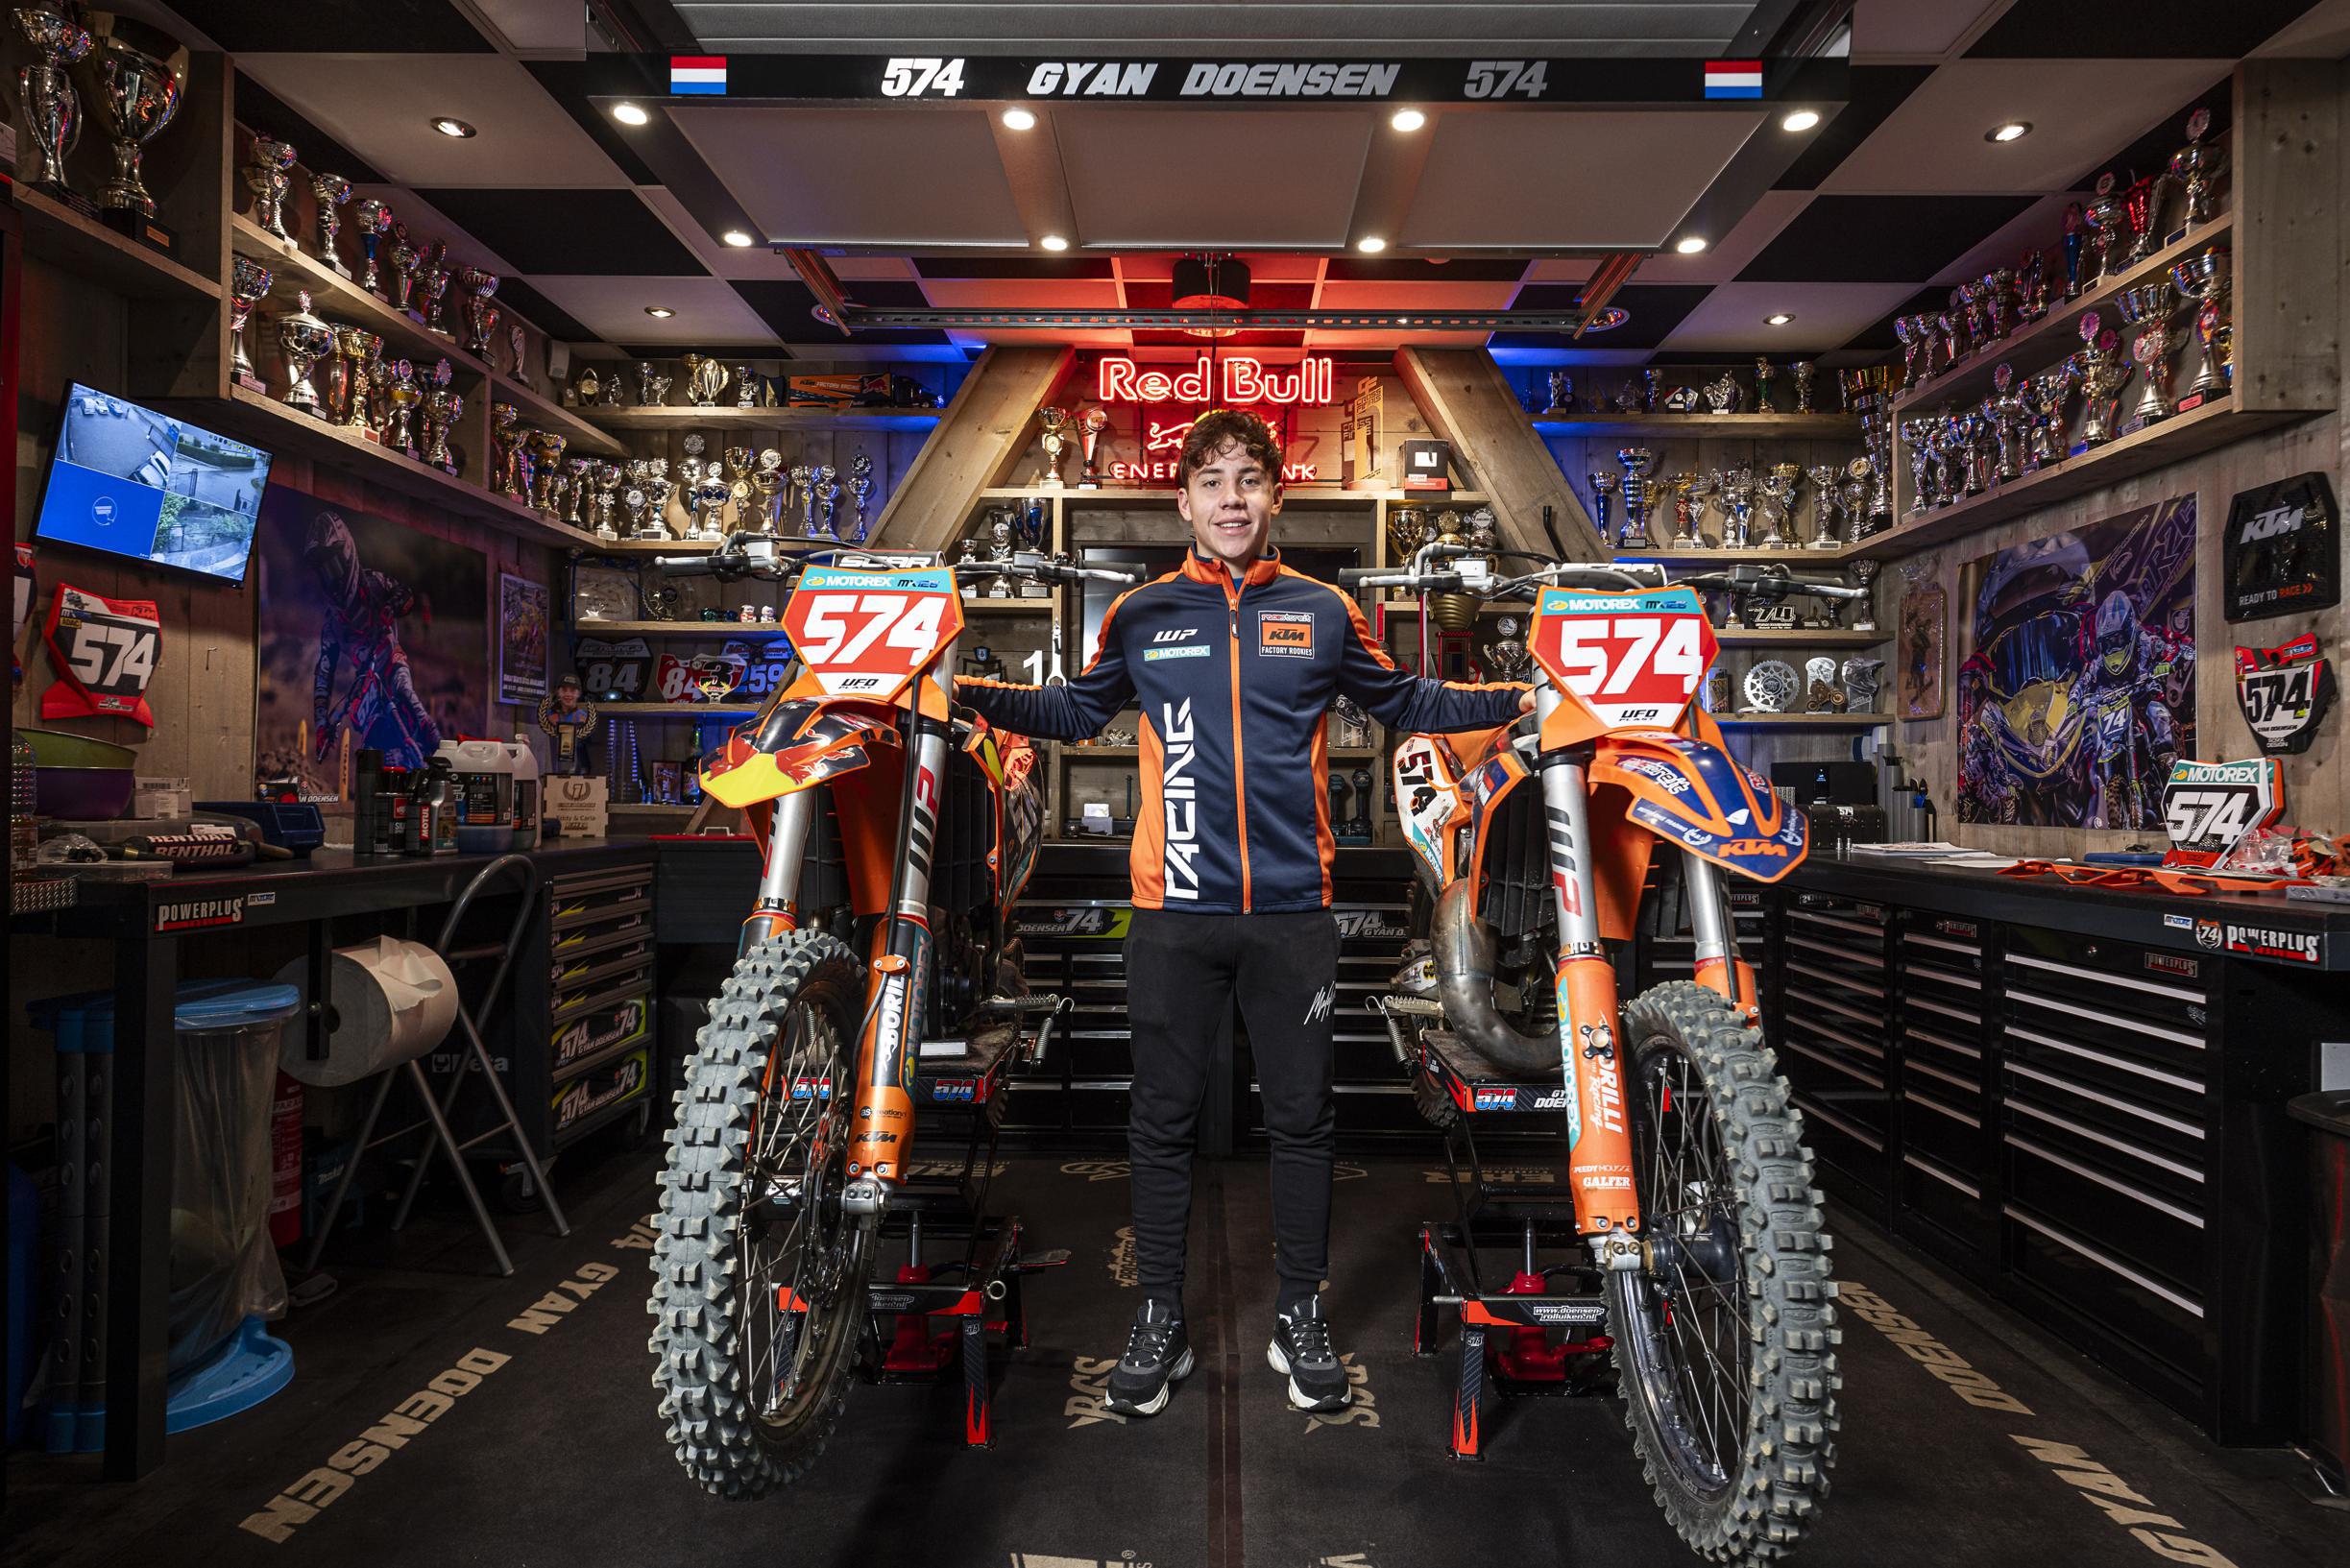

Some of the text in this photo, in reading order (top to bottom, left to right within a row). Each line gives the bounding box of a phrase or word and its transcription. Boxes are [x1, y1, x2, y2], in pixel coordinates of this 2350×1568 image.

[881, 58, 964, 96] 574
[1026, 62, 1400, 96] GYAN DOENSEN
[1464, 60, 1547, 98] 574
[1100, 357, 1332, 403] Red Bull
[2240, 505, 2303, 544] KTM
[826, 575, 893, 588] MOTOREX
[2239, 586, 2300, 606] READY TO RACE
[1569, 597, 1640, 611] MOTOREX
[799, 594, 947, 666] 574
[1152, 629, 1199, 642] WP
[1268, 628, 1305, 641] KTM
[68, 622, 156, 690] 574
[1158, 646, 1207, 658] MOTOREX
[1261, 646, 1313, 657] FACTORY ROOKIES
[1560, 618, 1704, 697] 574
[586, 663, 639, 692] 84
[663, 667, 699, 700] 84
[841, 678, 880, 688] UFO
[2246, 671, 2311, 724] 574
[1620, 709, 1659, 719] UFO
[2103, 712, 2126, 736] 74
[2187, 767, 2257, 783] MOTOREX
[1163, 696, 1199, 900] RACING
[422, 806, 430, 838] MOTUL
[2166, 791, 2249, 845] 574
[148, 834, 236, 843] RENTHAL
[155, 844, 236, 857] RENTHAL
[1717, 839, 1788, 857] KTM
[157, 899, 242, 931] POWERPLUS
[1064, 908, 1103, 933] 74
[1363, 927, 1395, 937] GYAN
[2227, 925, 2318, 962] POWERPLUS
[2147, 955, 2195, 976] POWERPLUS
[619, 1005, 638, 1034] 74
[883, 973, 905, 1072] BORIL
[560, 1020, 590, 1062] 574
[619, 1061, 638, 1092] 74
[933, 1078, 977, 1102] 574
[1559, 1025, 1583, 1134] MOTOREX
[560, 1079, 590, 1122] 574
[1474, 1088, 1517, 1111] 574
[854, 1131, 897, 1144] KTM
[1583, 1176, 1631, 1187] GALFER
[506, 1262, 619, 1335] GYAN
[1535, 1307, 1603, 1316] www.doensen-
[1837, 1281, 2036, 1415] DOENSEN
[238, 1347, 513, 1544] DOENSEN
[2007, 1434, 2238, 1568] GYAN
